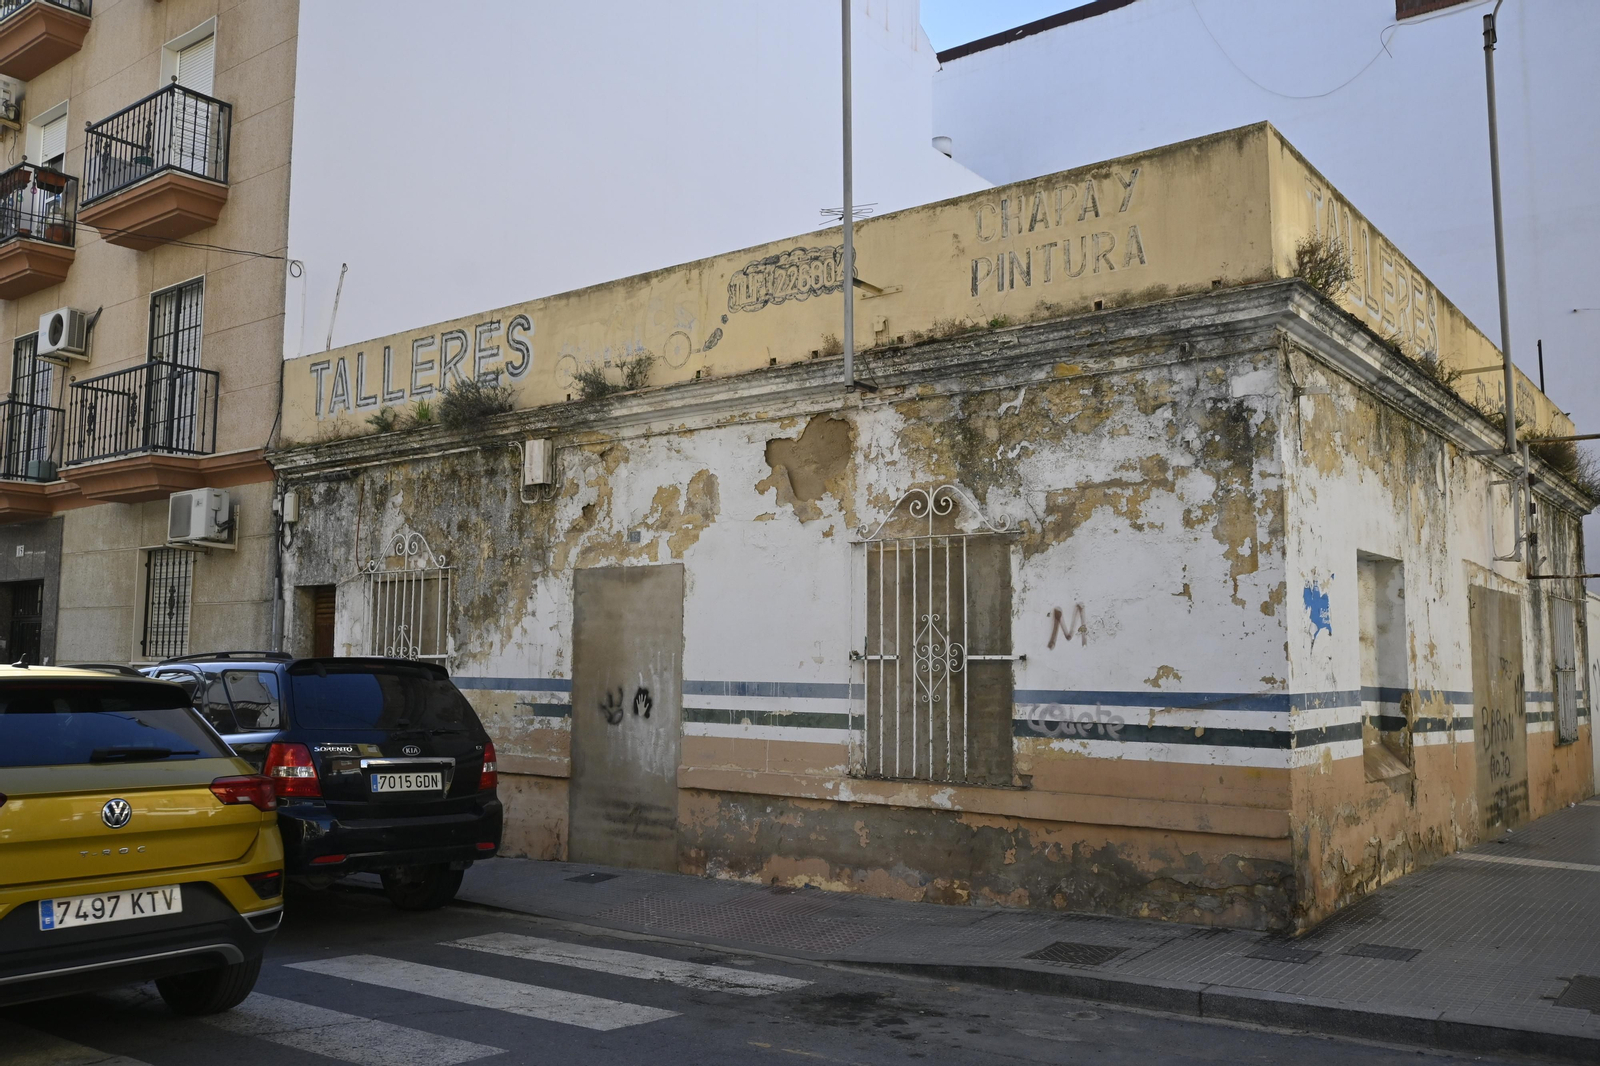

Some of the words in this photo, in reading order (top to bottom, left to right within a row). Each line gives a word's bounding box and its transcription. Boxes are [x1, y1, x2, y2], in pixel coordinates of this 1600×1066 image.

[975, 178, 1100, 243] CHAPA
[1115, 168, 1140, 213] Y
[971, 224, 1148, 297] PINTURA
[1304, 174, 1438, 362] TALLERES
[309, 313, 533, 420] TALLERES
[403, 746, 419, 755] KIA
[379, 775, 411, 789] 7015
[415, 774, 438, 788] GDN
[79, 846, 146, 857] T-ROC
[57, 895, 121, 925] 7497
[131, 889, 174, 915] KTV
